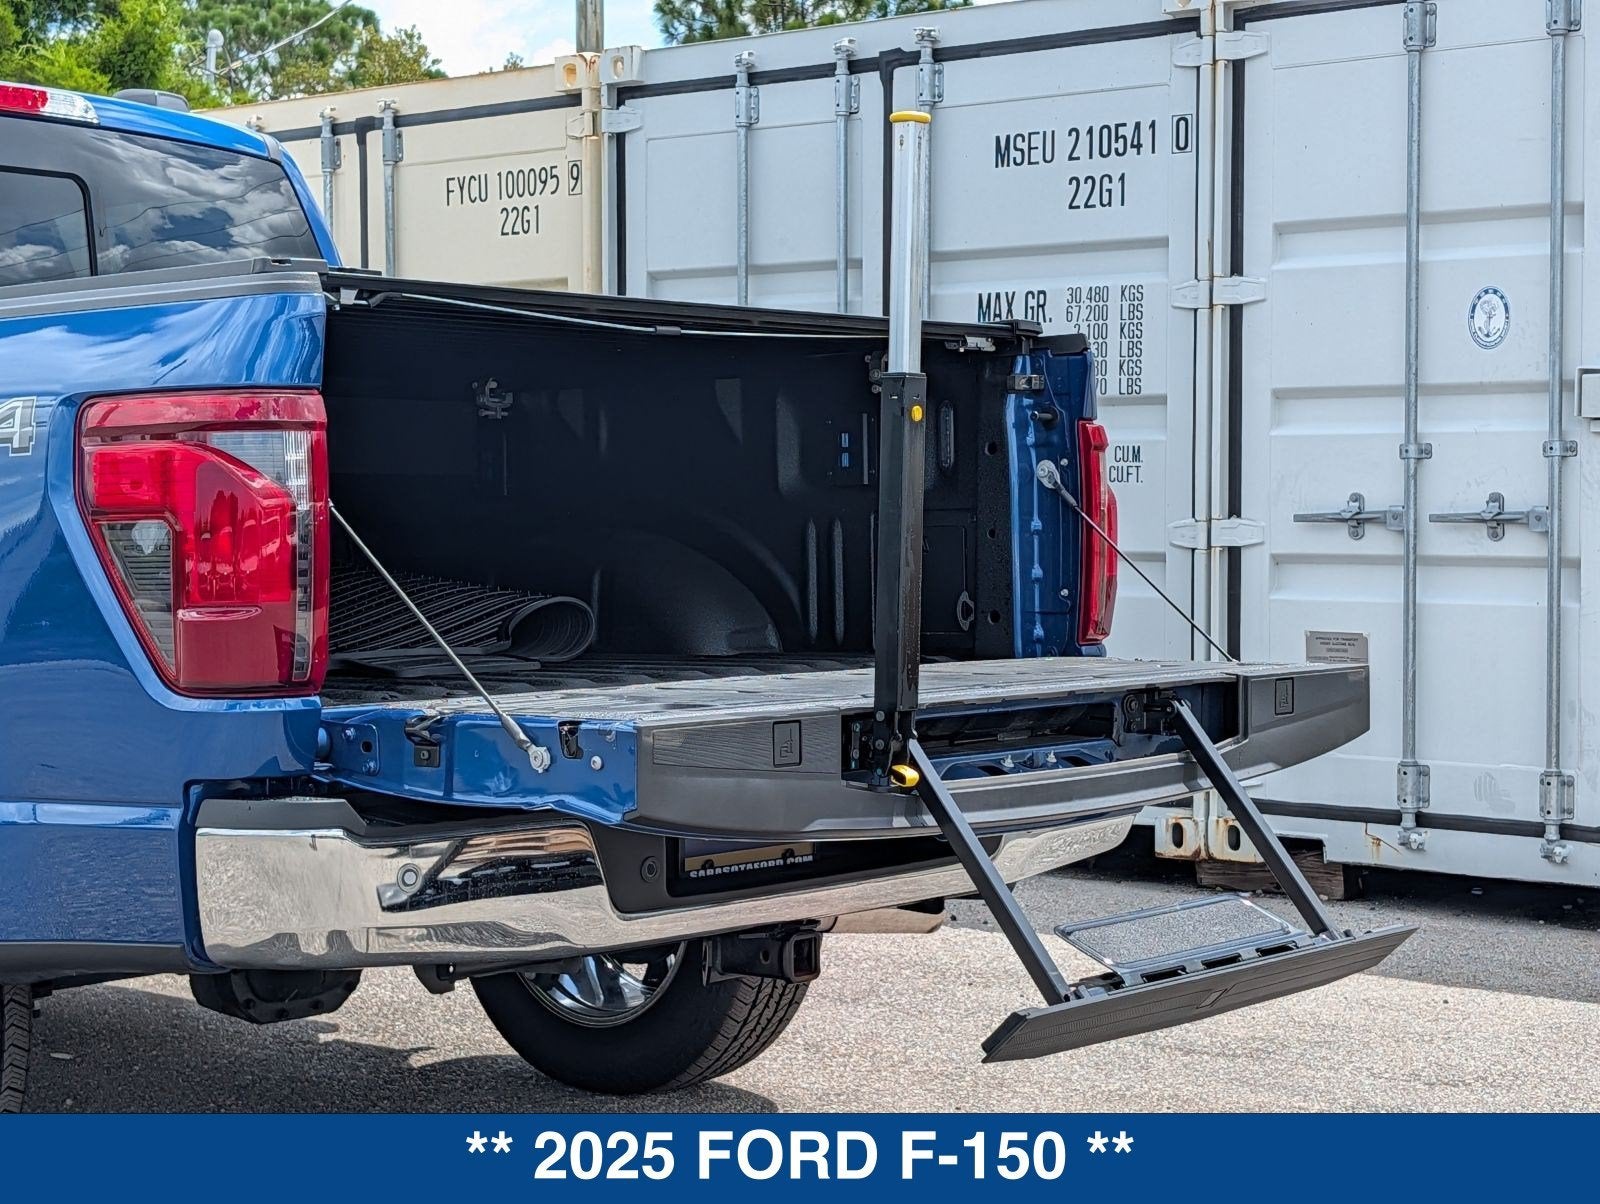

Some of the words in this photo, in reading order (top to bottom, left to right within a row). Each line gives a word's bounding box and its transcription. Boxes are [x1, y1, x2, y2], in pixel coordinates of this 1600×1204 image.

[994, 129, 1055, 168] MSEU
[1067, 119, 1157, 162] 210541
[446, 173, 488, 206] FYCU
[497, 165, 559, 200] 100095
[570, 162, 581, 193] 9
[1068, 172, 1126, 210] 22G1
[500, 205, 539, 236] 22G1
[978, 291, 1016, 323] MAX
[1024, 290, 1053, 323] GR.
[1121, 284, 1144, 302] KGS
[1120, 303, 1143, 321] LBS
[1119, 322, 1143, 340] KGS
[1119, 340, 1142, 358] LBS
[1118, 359, 1142, 376] KGS
[1118, 377, 1142, 395] LBS
[1114, 445, 1143, 463] CU.M.
[1108, 466, 1143, 483] CU.FT.
